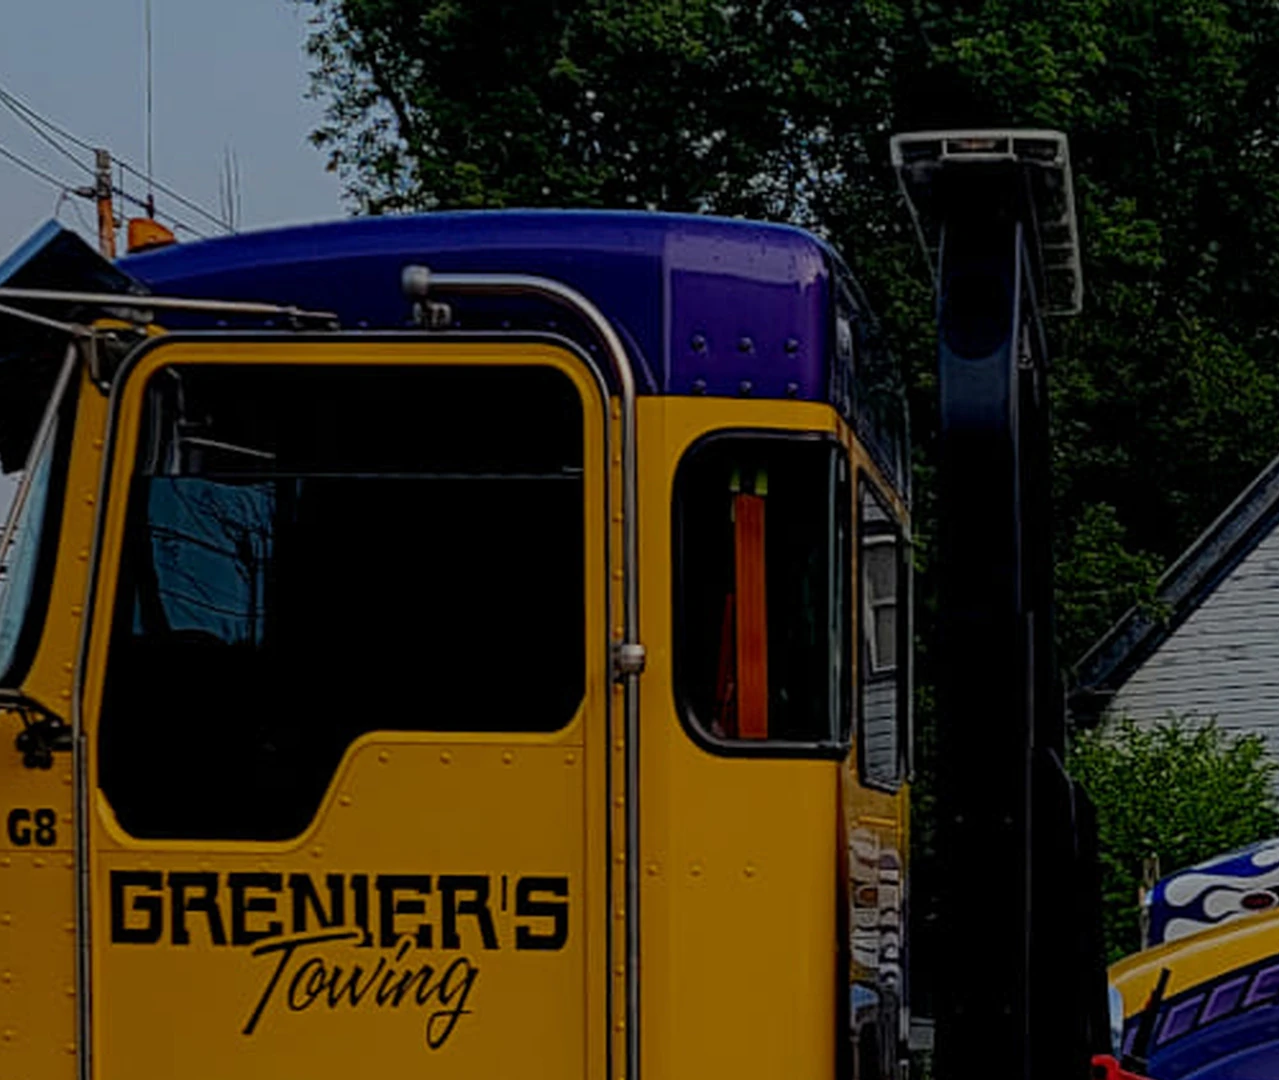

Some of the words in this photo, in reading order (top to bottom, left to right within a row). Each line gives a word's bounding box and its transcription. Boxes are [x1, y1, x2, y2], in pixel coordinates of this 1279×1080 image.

[7, 808, 57, 847] G8
[110, 870, 570, 950] GRENIER'S
[242, 931, 479, 1050] Towing
